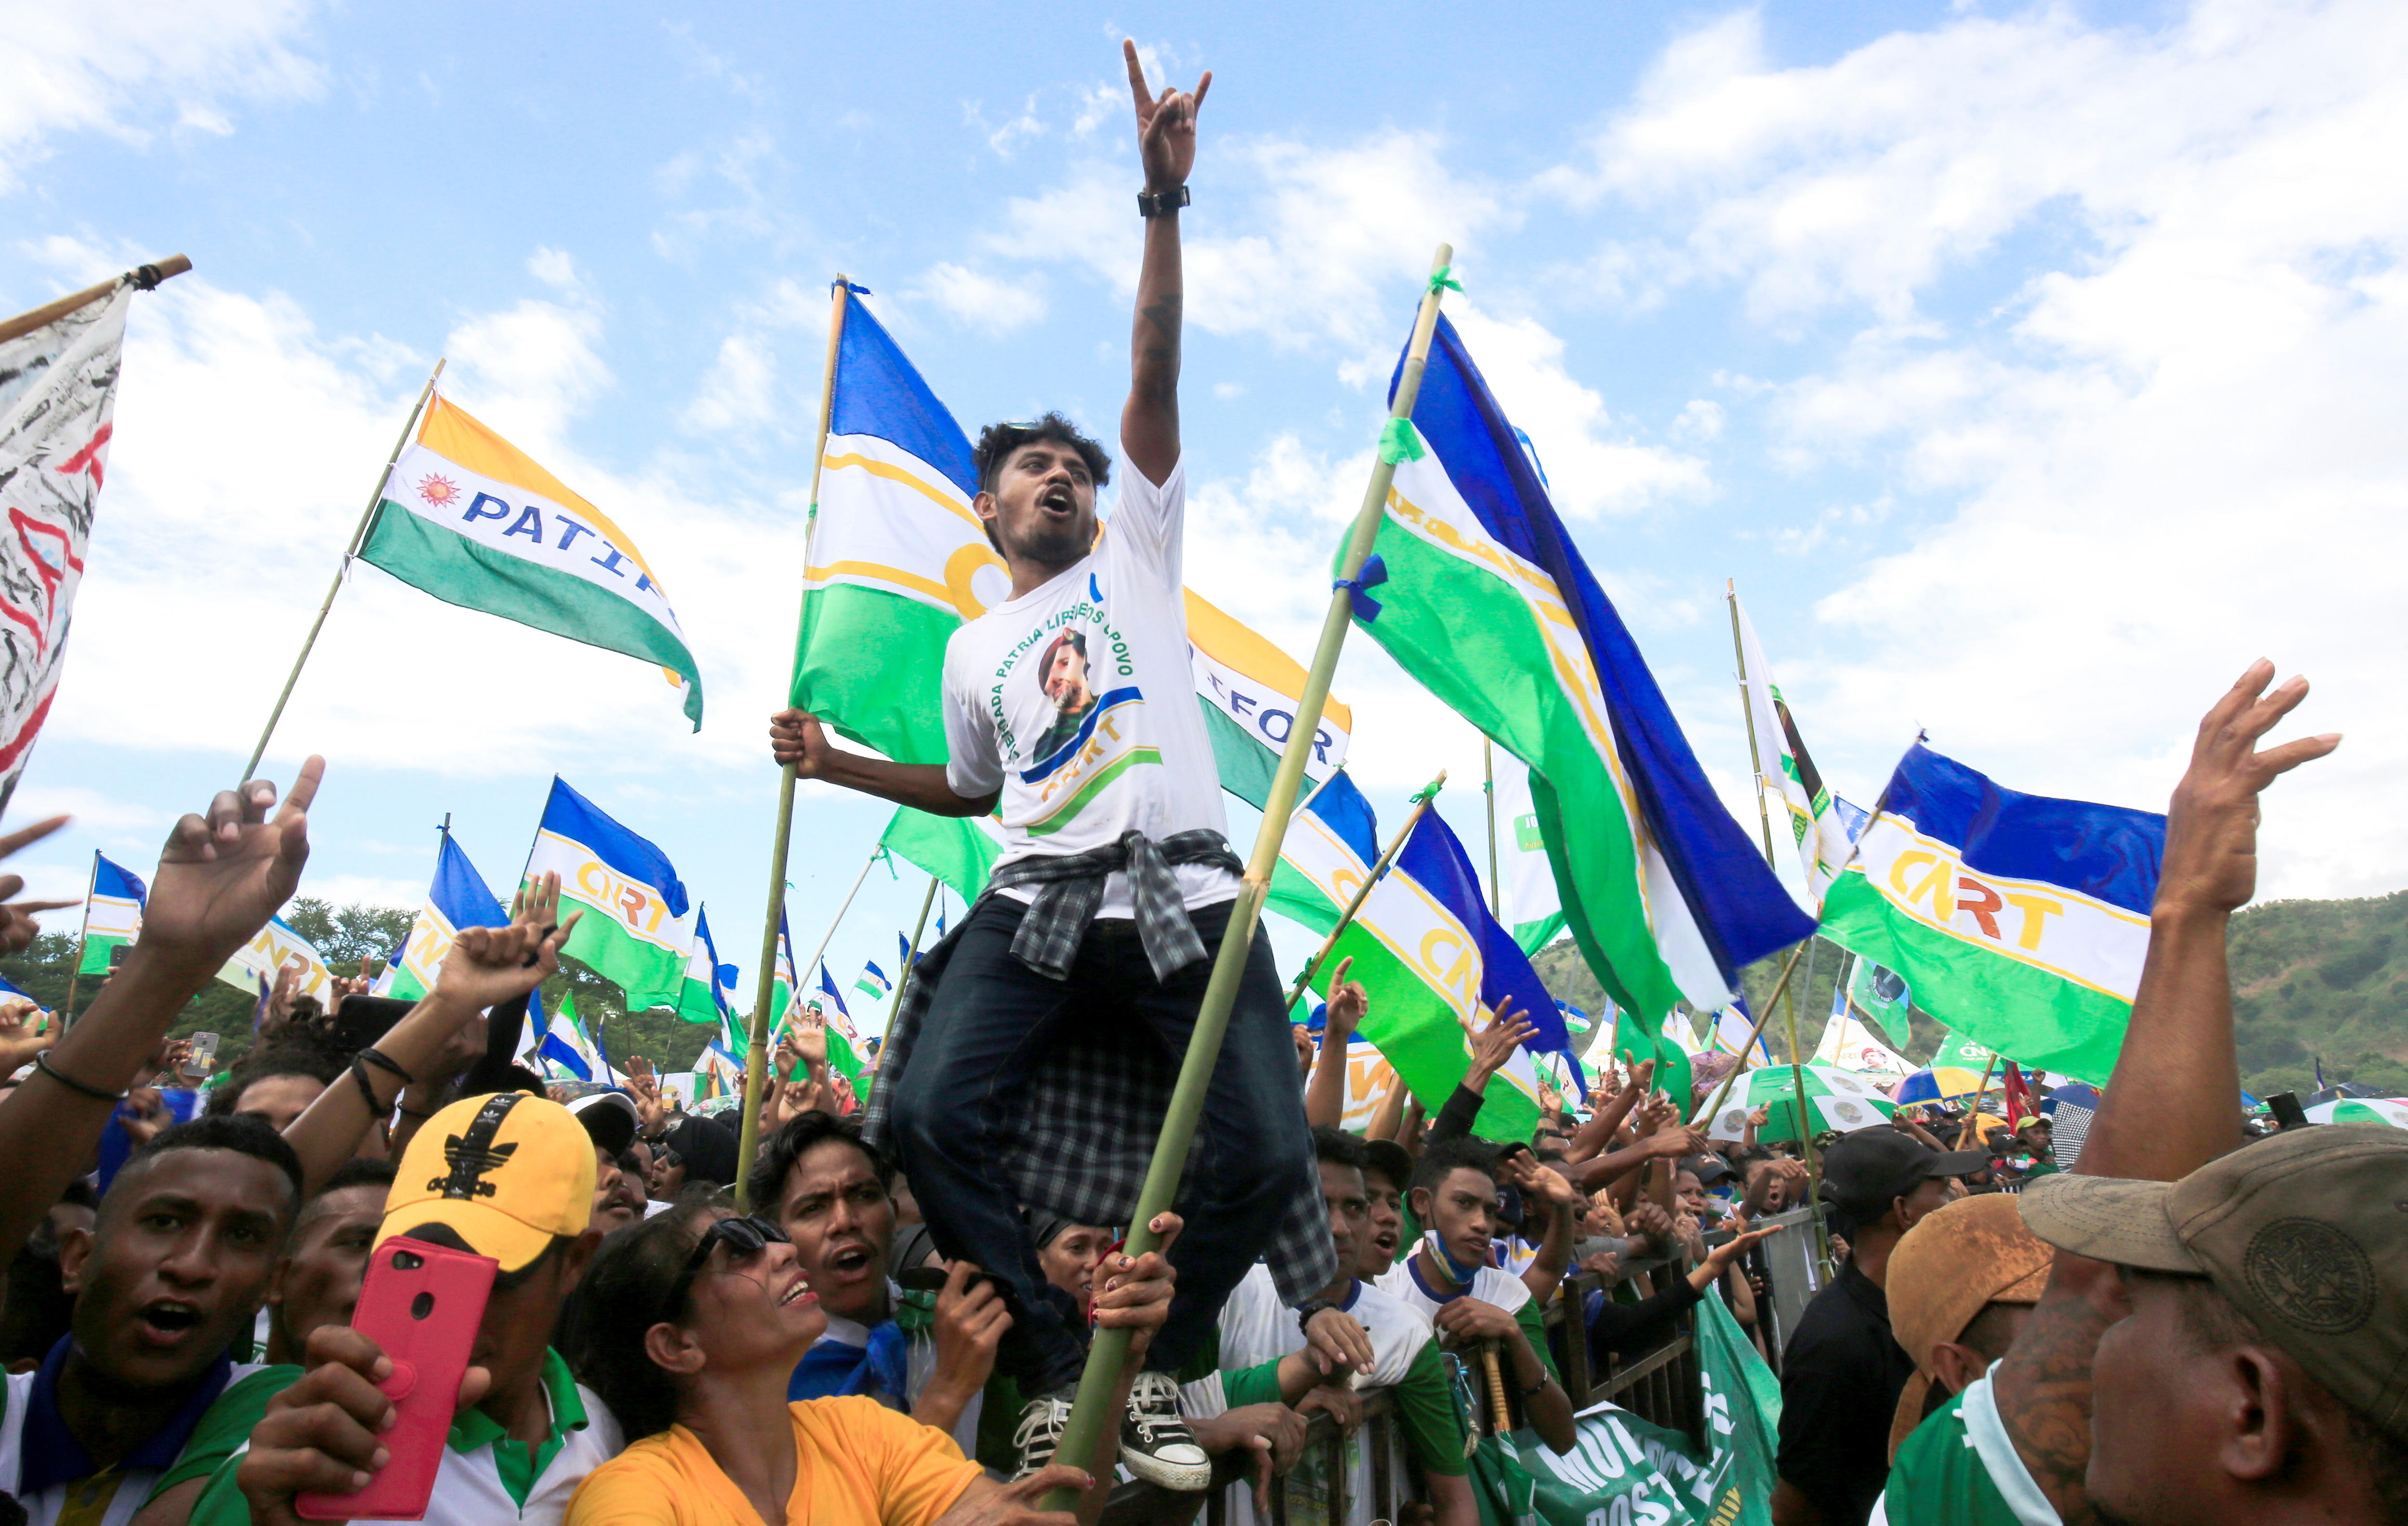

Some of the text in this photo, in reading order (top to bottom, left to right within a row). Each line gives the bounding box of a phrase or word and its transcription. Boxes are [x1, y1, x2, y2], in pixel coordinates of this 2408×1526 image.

[995, 628, 1043, 678] PATRIA
[1107, 630, 1133, 676] POVO
[577, 861, 669, 934] CNRT
[1889, 850, 2064, 952] CNRT
[247, 928, 333, 995] NRT
[407, 919, 453, 969] CN
[1419, 928, 1495, 1028] CN
[1959, 1045, 1993, 1057] CN
[427, 1176, 497, 1198] adas
